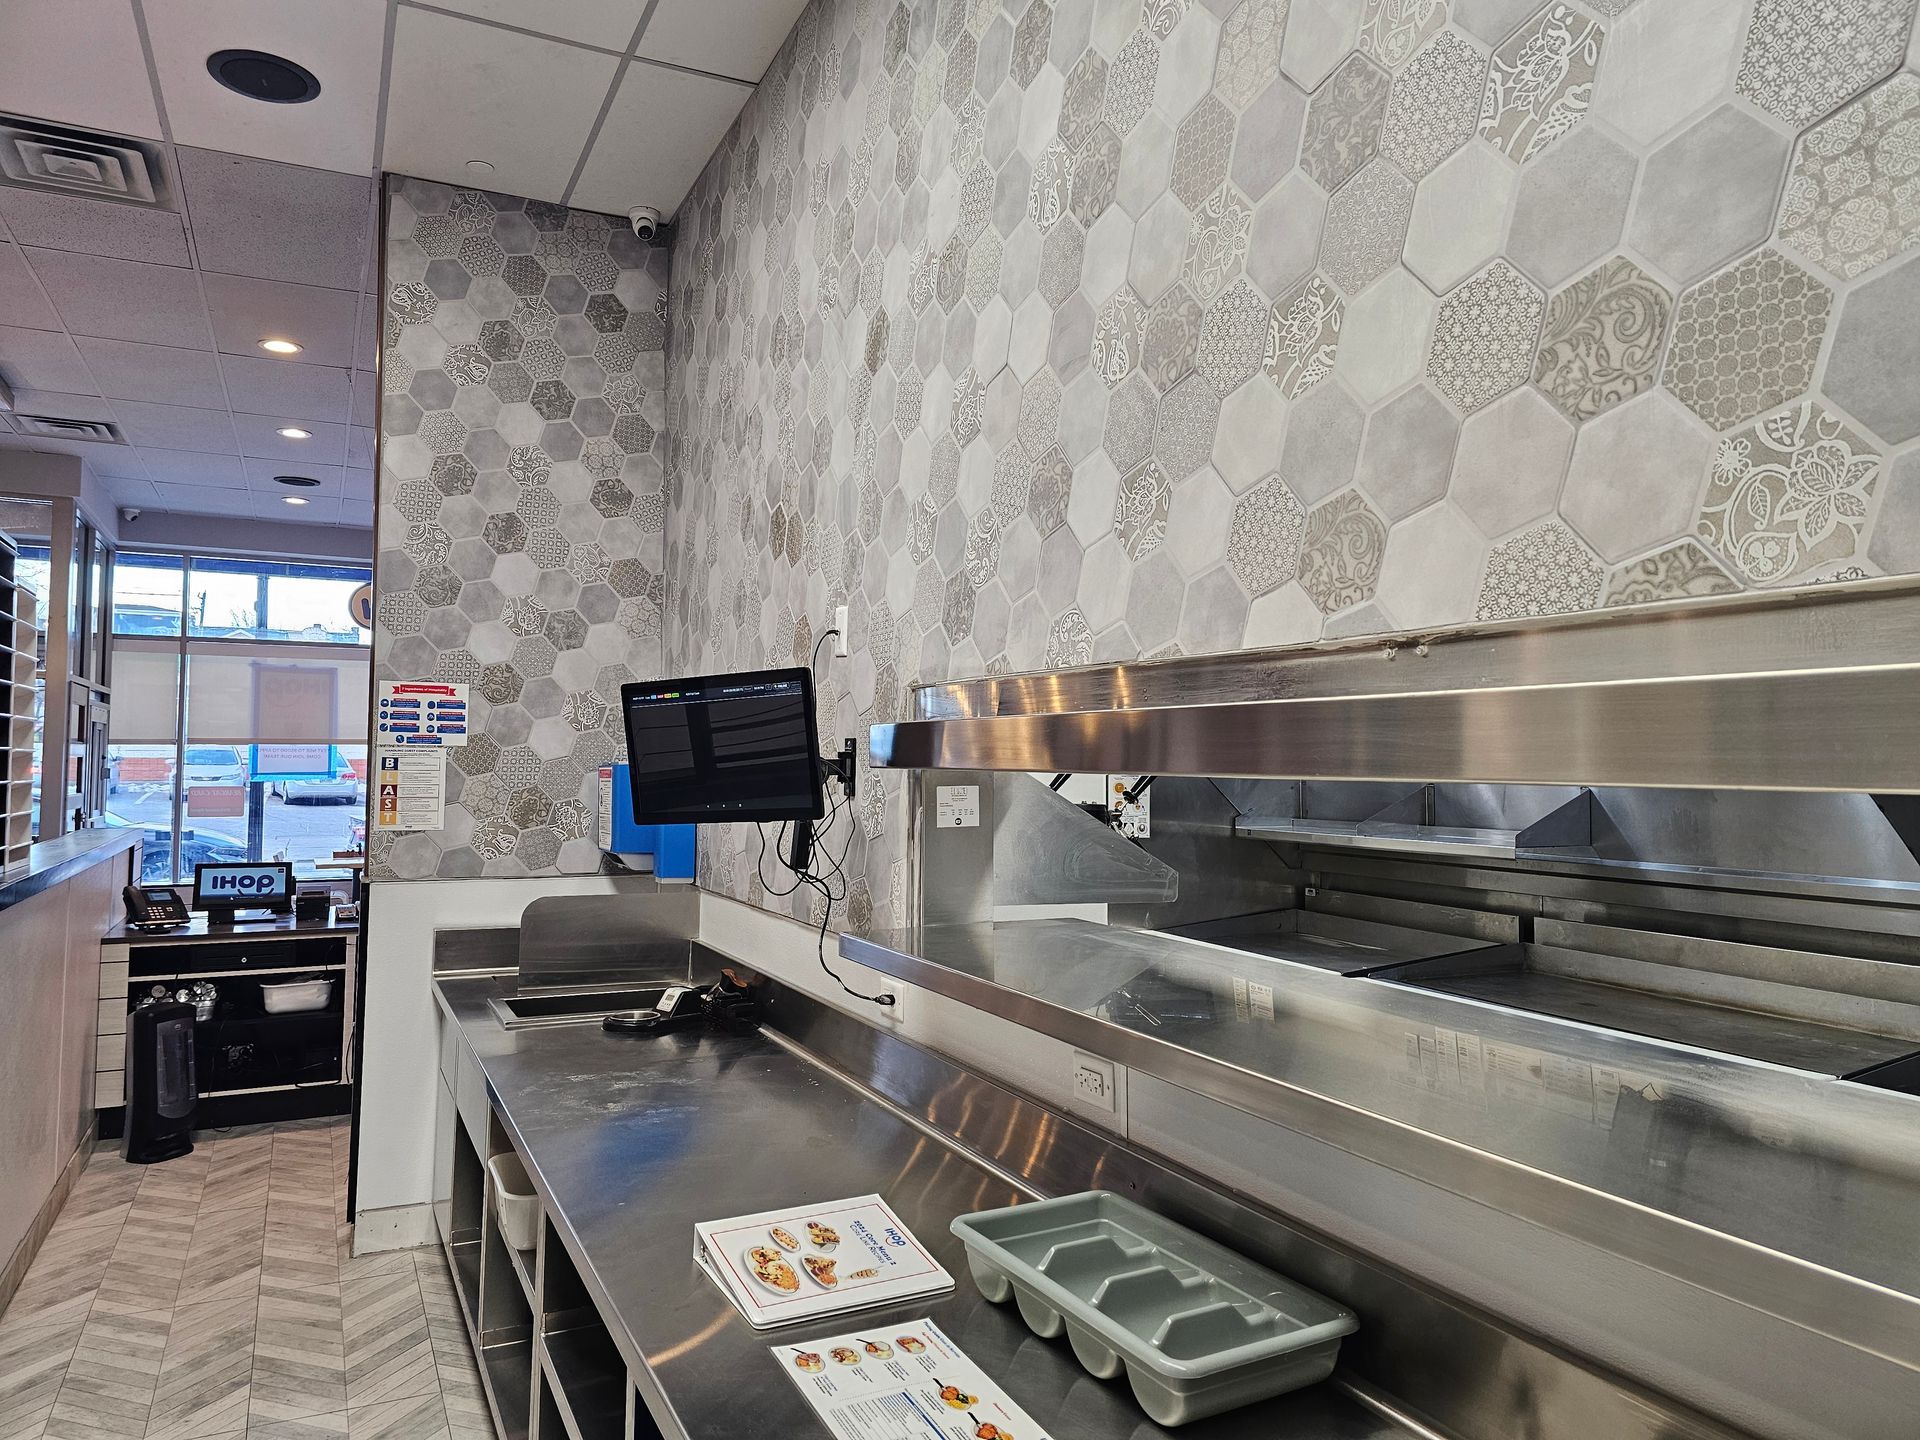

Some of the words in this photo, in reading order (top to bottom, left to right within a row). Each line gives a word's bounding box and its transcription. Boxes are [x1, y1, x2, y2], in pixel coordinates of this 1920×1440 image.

[385, 758, 395, 768] B
[383, 785, 394, 795] A
[384, 799, 392, 809] S
[383, 812, 393, 823] T
[212, 875, 275, 893] IHOP
[884, 1228, 906, 1246] IHOP
[876, 1246, 893, 1261] Menu
